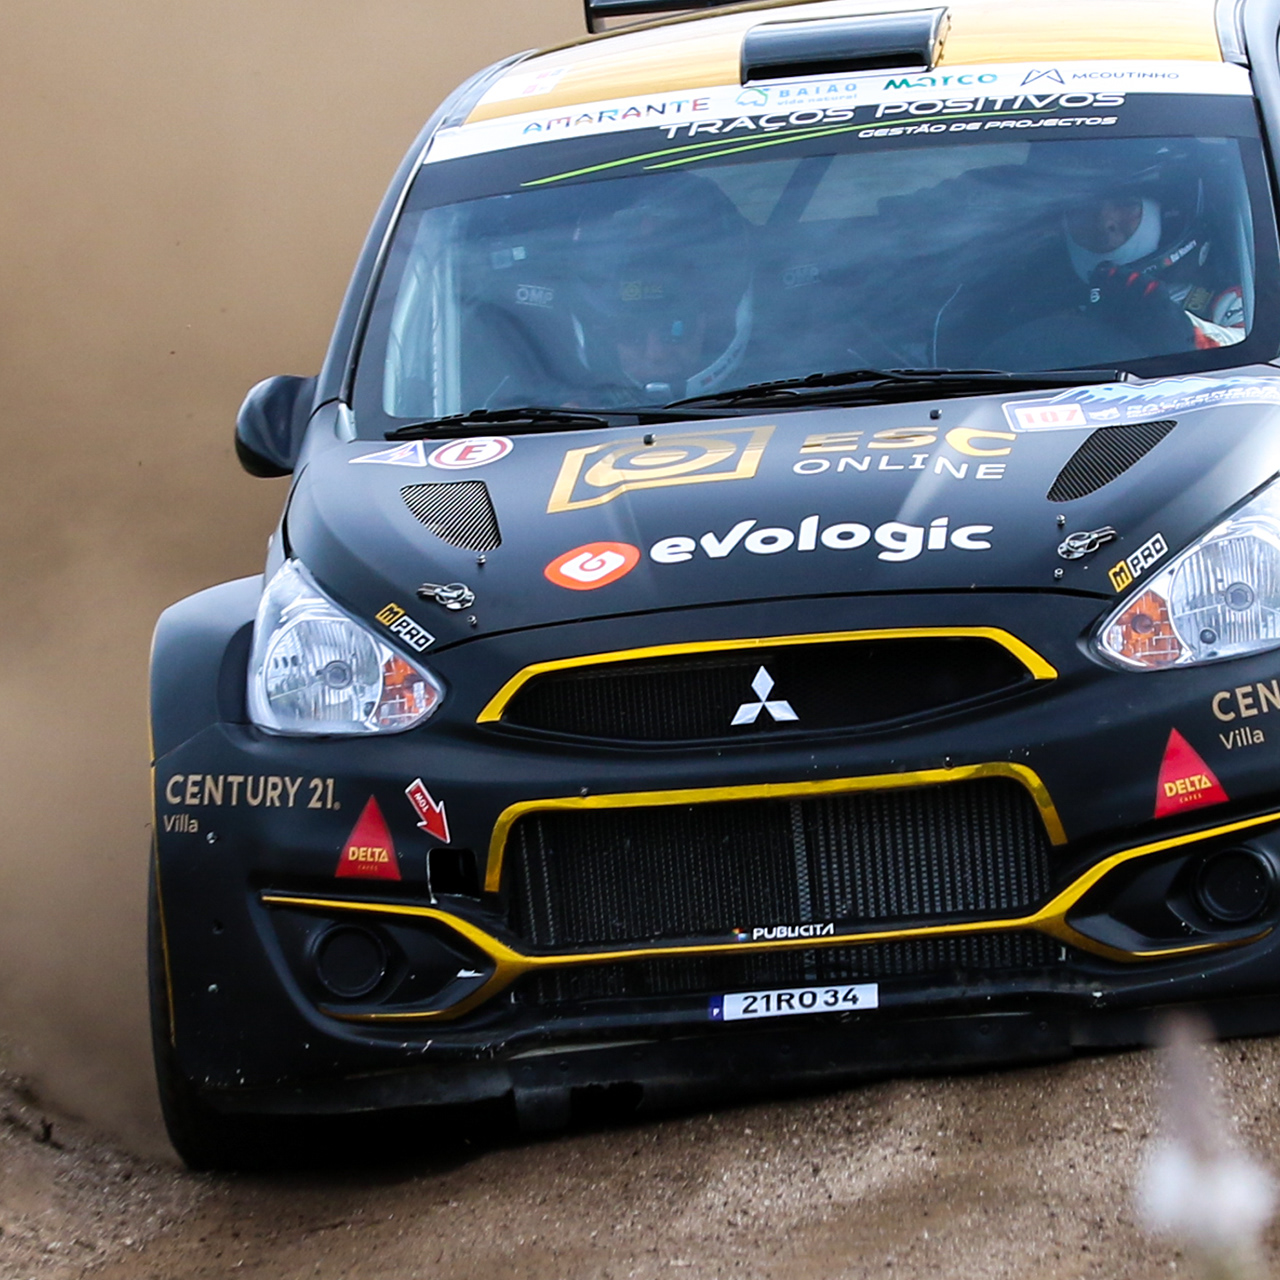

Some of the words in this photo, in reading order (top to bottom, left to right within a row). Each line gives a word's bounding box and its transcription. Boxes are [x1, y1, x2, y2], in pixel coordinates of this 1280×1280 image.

[1072, 71, 1180, 80] MCOUTINHO
[806, 93, 858, 105] natural
[522, 97, 711, 135] AMARANTE
[658, 106, 857, 139] TRAÇOS
[875, 92, 1127, 118] POSITIVOS
[858, 122, 947, 138] GESTÃO
[949, 121, 983, 132] DE
[984, 116, 1119, 130] PROJECTOS
[1023, 409, 1078, 424] 107
[799, 427, 1017, 457] ESC
[793, 453, 1007, 479] ONLINE
[1219, 726, 1265, 750] Villa
[165, 774, 303, 808] CENTURY
[1163, 773, 1212, 797] DELTA
[413, 791, 429, 813] TOW
[163, 814, 198, 833] Villa
[348, 846, 389, 863] DELTA
